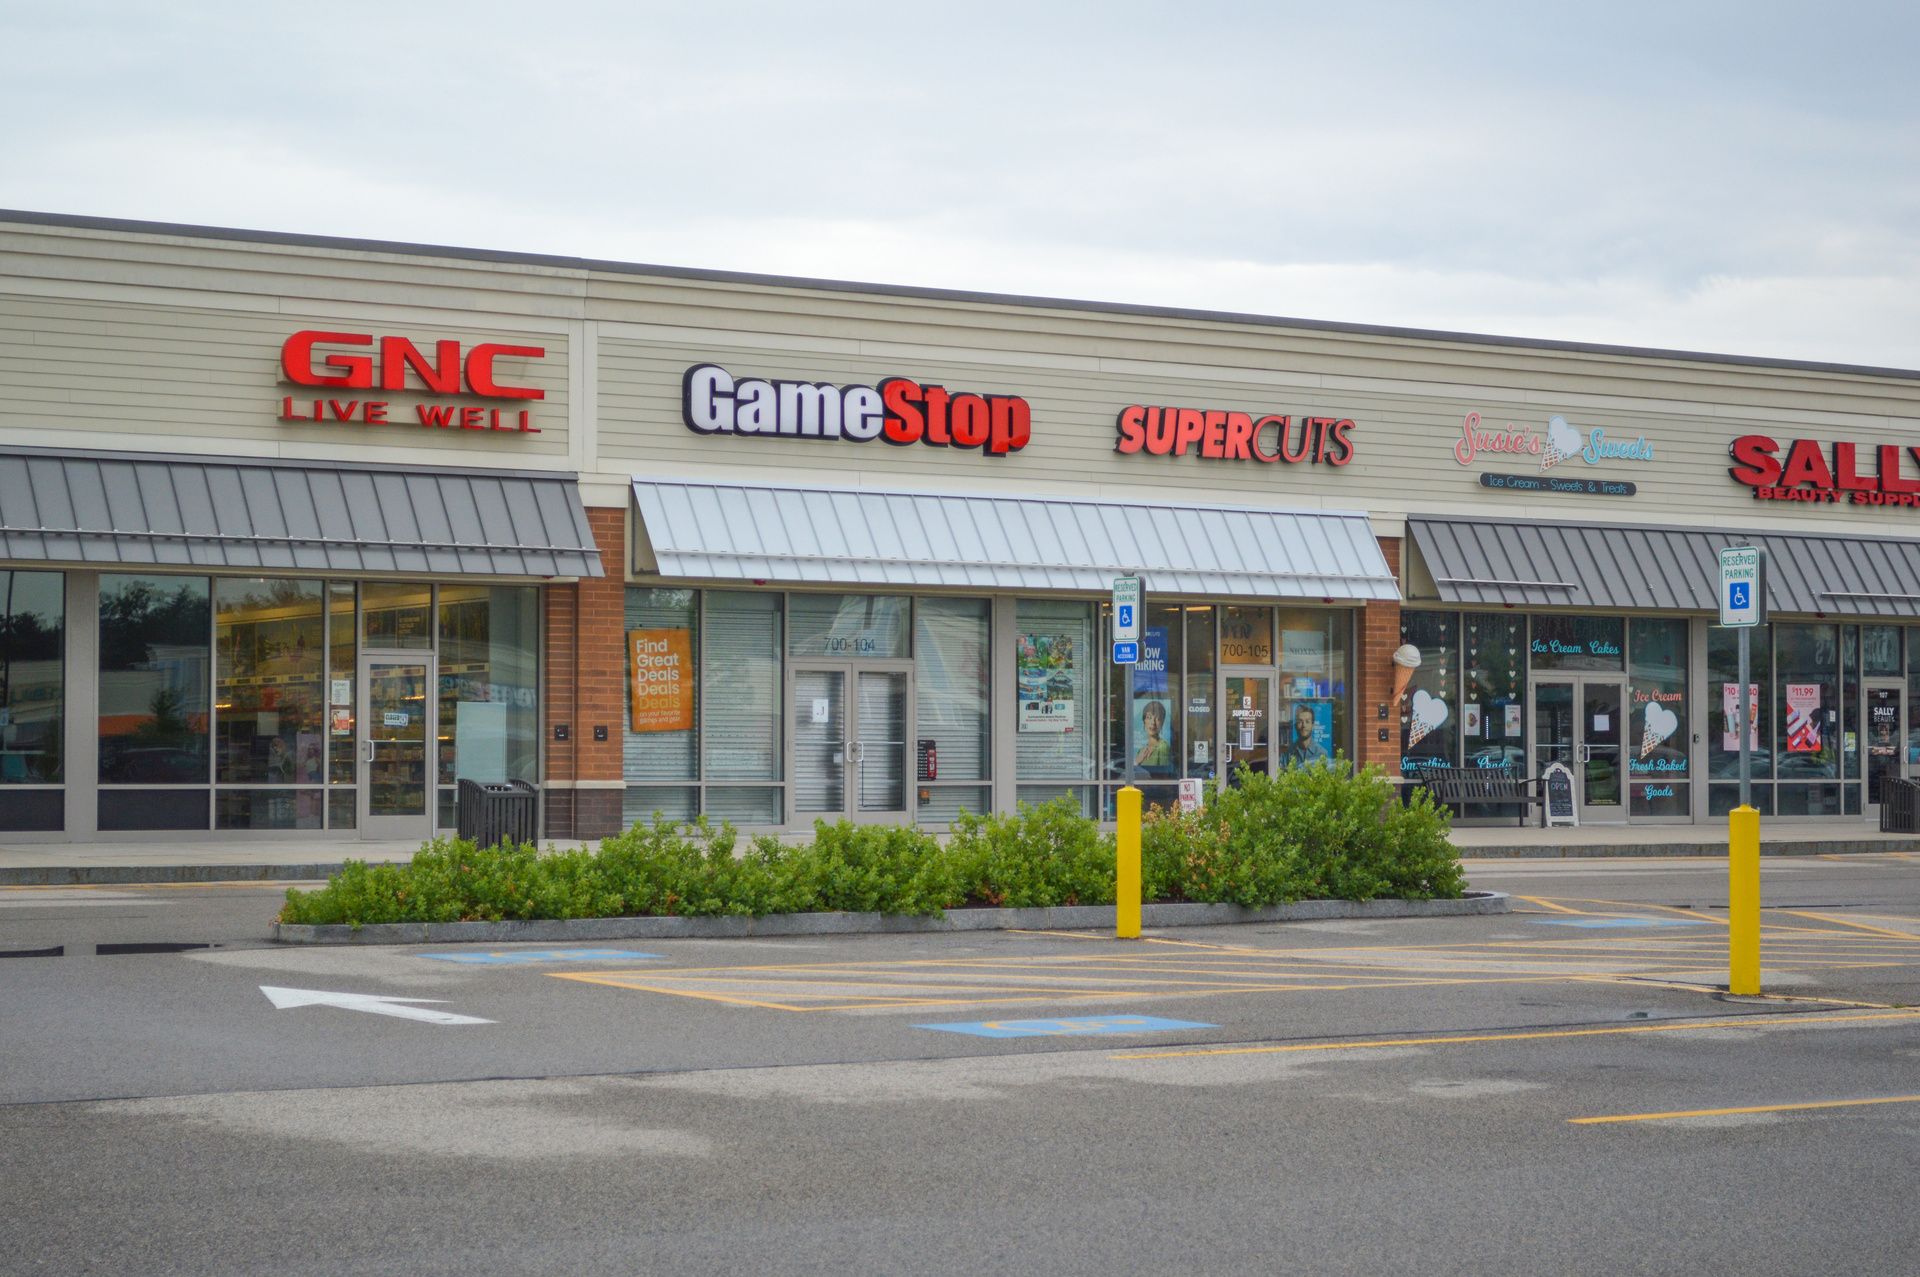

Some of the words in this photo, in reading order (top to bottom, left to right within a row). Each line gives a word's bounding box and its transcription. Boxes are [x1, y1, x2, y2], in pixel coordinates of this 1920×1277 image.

[281, 330, 545, 400] GNC
[283, 396, 388, 425] LIVE
[416, 403, 541, 433] WELL
[681, 363, 1031, 457] GameStop
[1115, 405, 1356, 466] SUPERCUTS
[1454, 411, 1541, 466] Susie's
[1583, 427, 1655, 465] Sweets
[1728, 435, 1920, 492] SALL
[1489, 475, 1504, 487] Ice
[1506, 476, 1540, 489] Cream
[1550, 479, 1583, 492] Sweets
[1587, 481, 1597, 492] &
[1602, 483, 1628, 495] Treats
[1753, 487, 1844, 504] BEAUTY
[1722, 555, 1756, 567] RESERVED
[1725, 568, 1754, 579] PARKING
[1115, 583, 1137, 592] RESERVED
[1116, 594, 1136, 602] PARKING
[637, 639, 667, 653] Find
[824, 637, 875, 651] 700-104
[1222, 644, 1268, 657] 700-105
[1532, 639, 1548, 653] Ice
[1550, 639, 1582, 653] Cream
[1589, 640, 1620, 654] Cakes
[637, 653, 679, 667] Great
[1144, 647, 1160, 659] OW
[638, 667, 679, 681] Deals
[639, 682, 680, 695] Deals
[1634, 690, 1649, 703] Ice
[1651, 688, 1682, 702] Cream
[1792, 687, 1814, 697] $11.99
[640, 695, 680, 709] Deals
[1232, 709, 1262, 718] SUPERCUTS
[1873, 707, 1895, 716] SALLY
[1630, 759, 1655, 773] Fresh
[1656, 758, 1687, 772] Baked
[1551, 782, 1568, 791] OPEN
[1644, 784, 1674, 800] Goods
